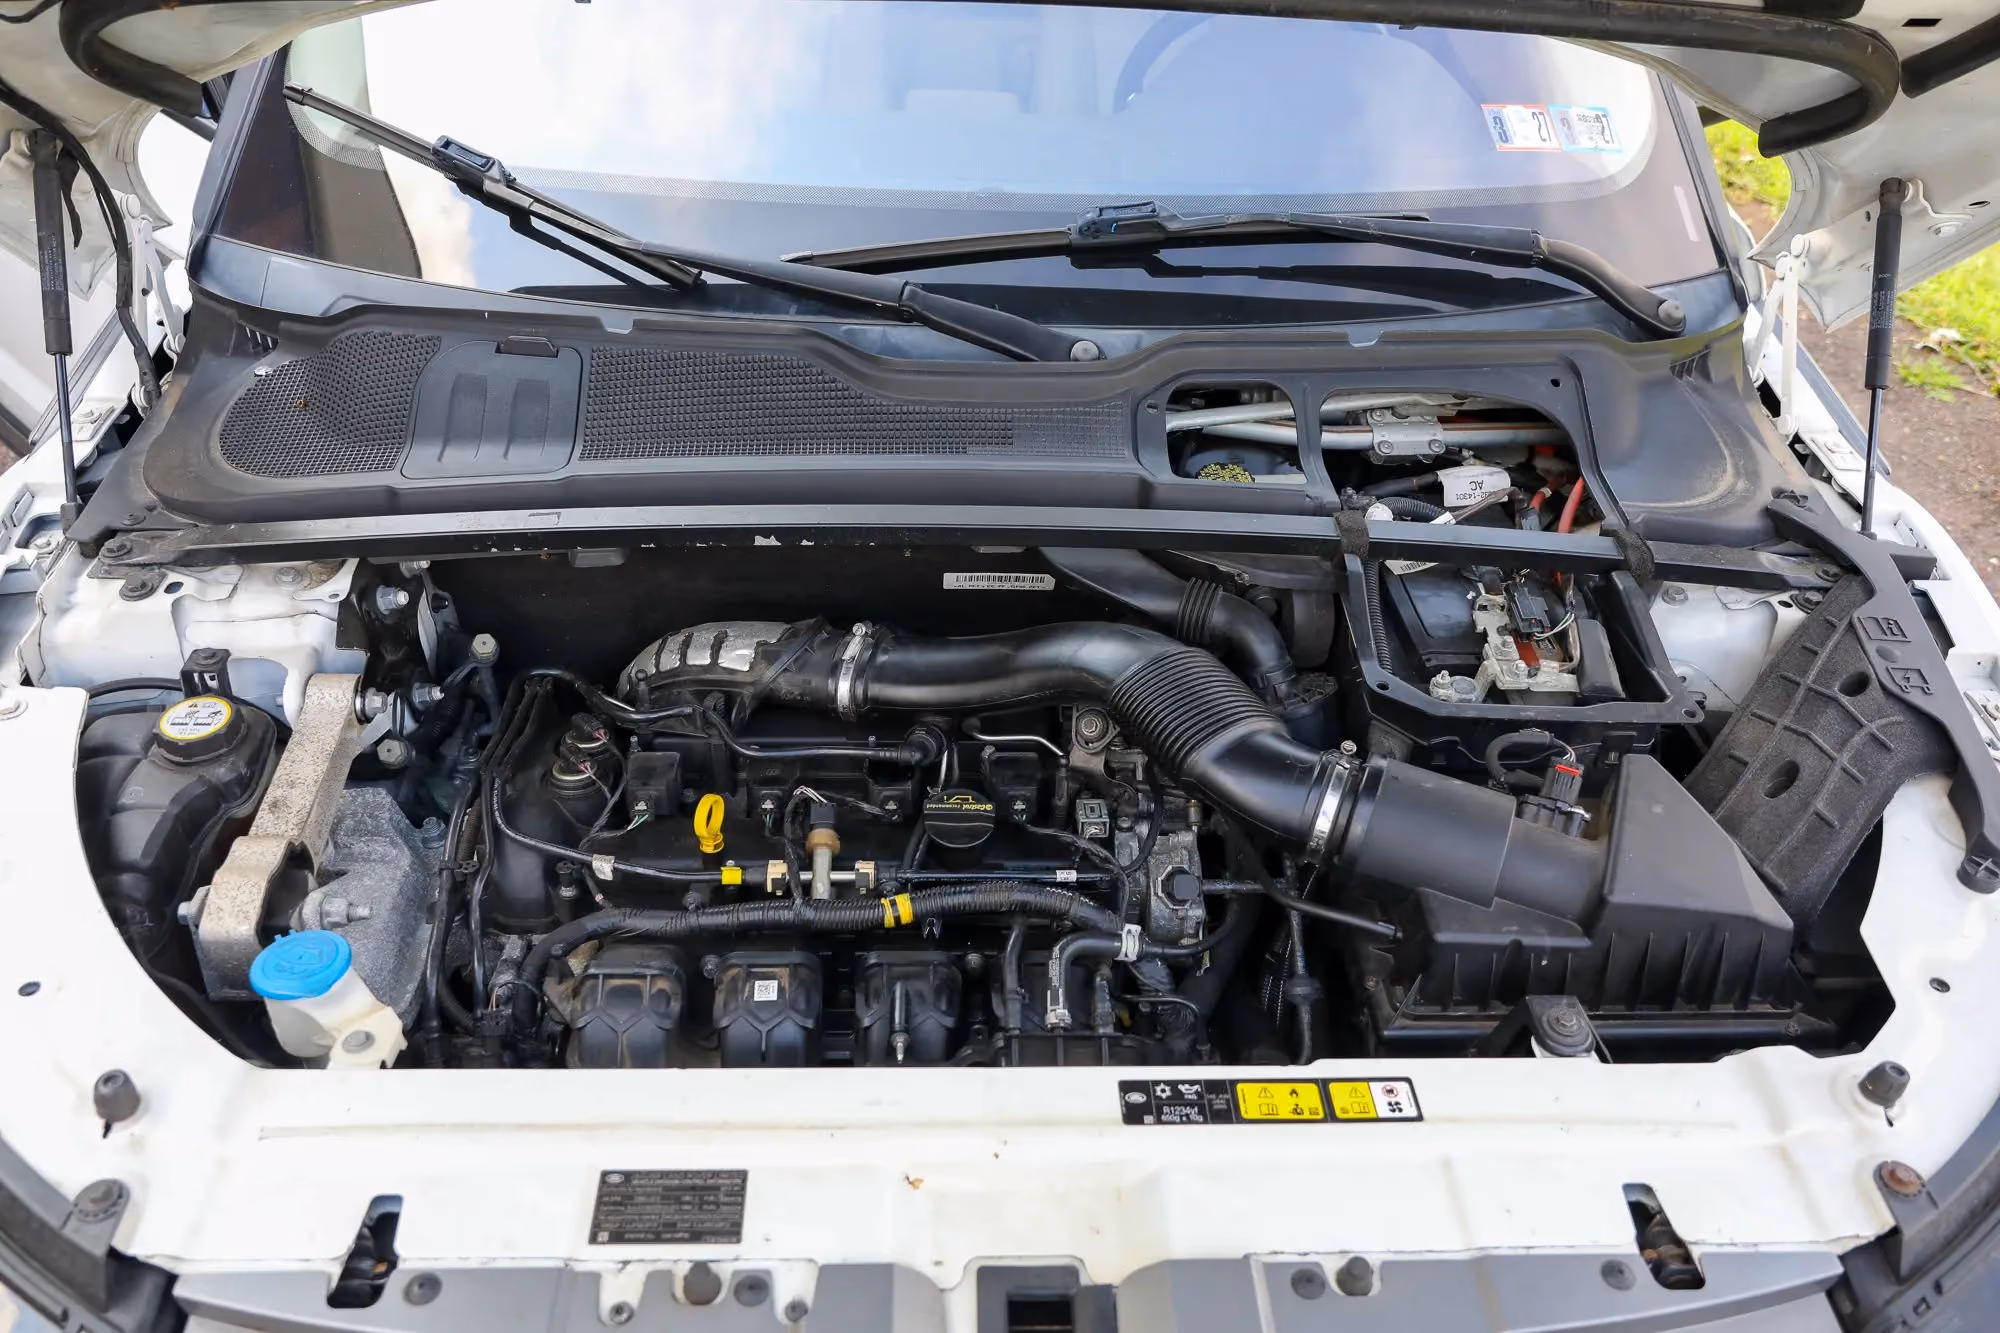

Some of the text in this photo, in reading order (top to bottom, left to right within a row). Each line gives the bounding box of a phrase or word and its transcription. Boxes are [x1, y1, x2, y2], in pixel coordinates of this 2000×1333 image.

[1532, 112, 1552, 143] 27
[1469, 480, 1484, 491] AC
[1162, 1105, 1199, 1115] R1234yf
